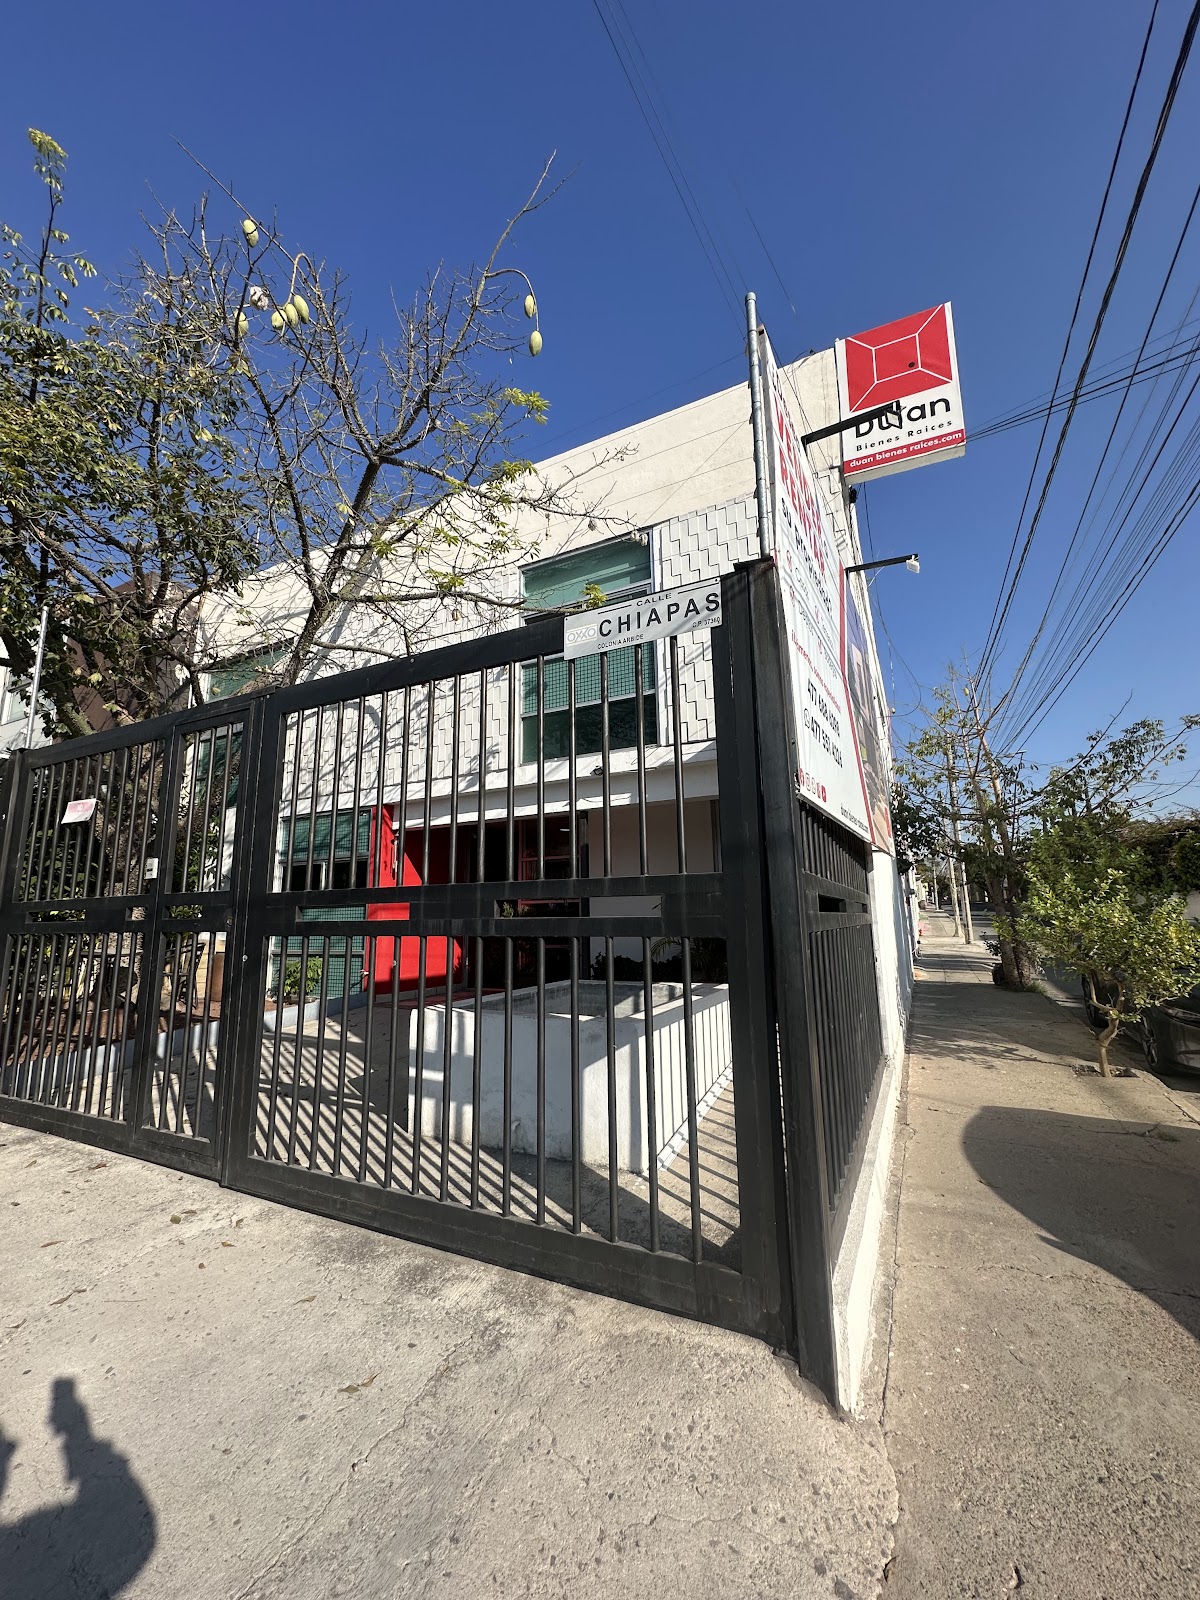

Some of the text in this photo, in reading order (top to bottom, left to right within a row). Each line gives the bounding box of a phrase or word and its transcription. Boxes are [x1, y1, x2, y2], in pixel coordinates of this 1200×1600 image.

[849, 432, 962, 468] duan bienes raices.com
[856, 420, 952, 452] Bienes Raices
[774, 392, 823, 548] VENDER
[778, 442, 827, 585] RENTAR
[780, 493, 792, 532] su
[598, 592, 720, 637] CHIAPAS
[636, 592, 672, 607] CALLE
[566, 627, 597, 642] OXXO
[597, 633, 644, 650] COLONIA ARBIDE
[806, 674, 817, 708] 477
[810, 713, 821, 744] 477
